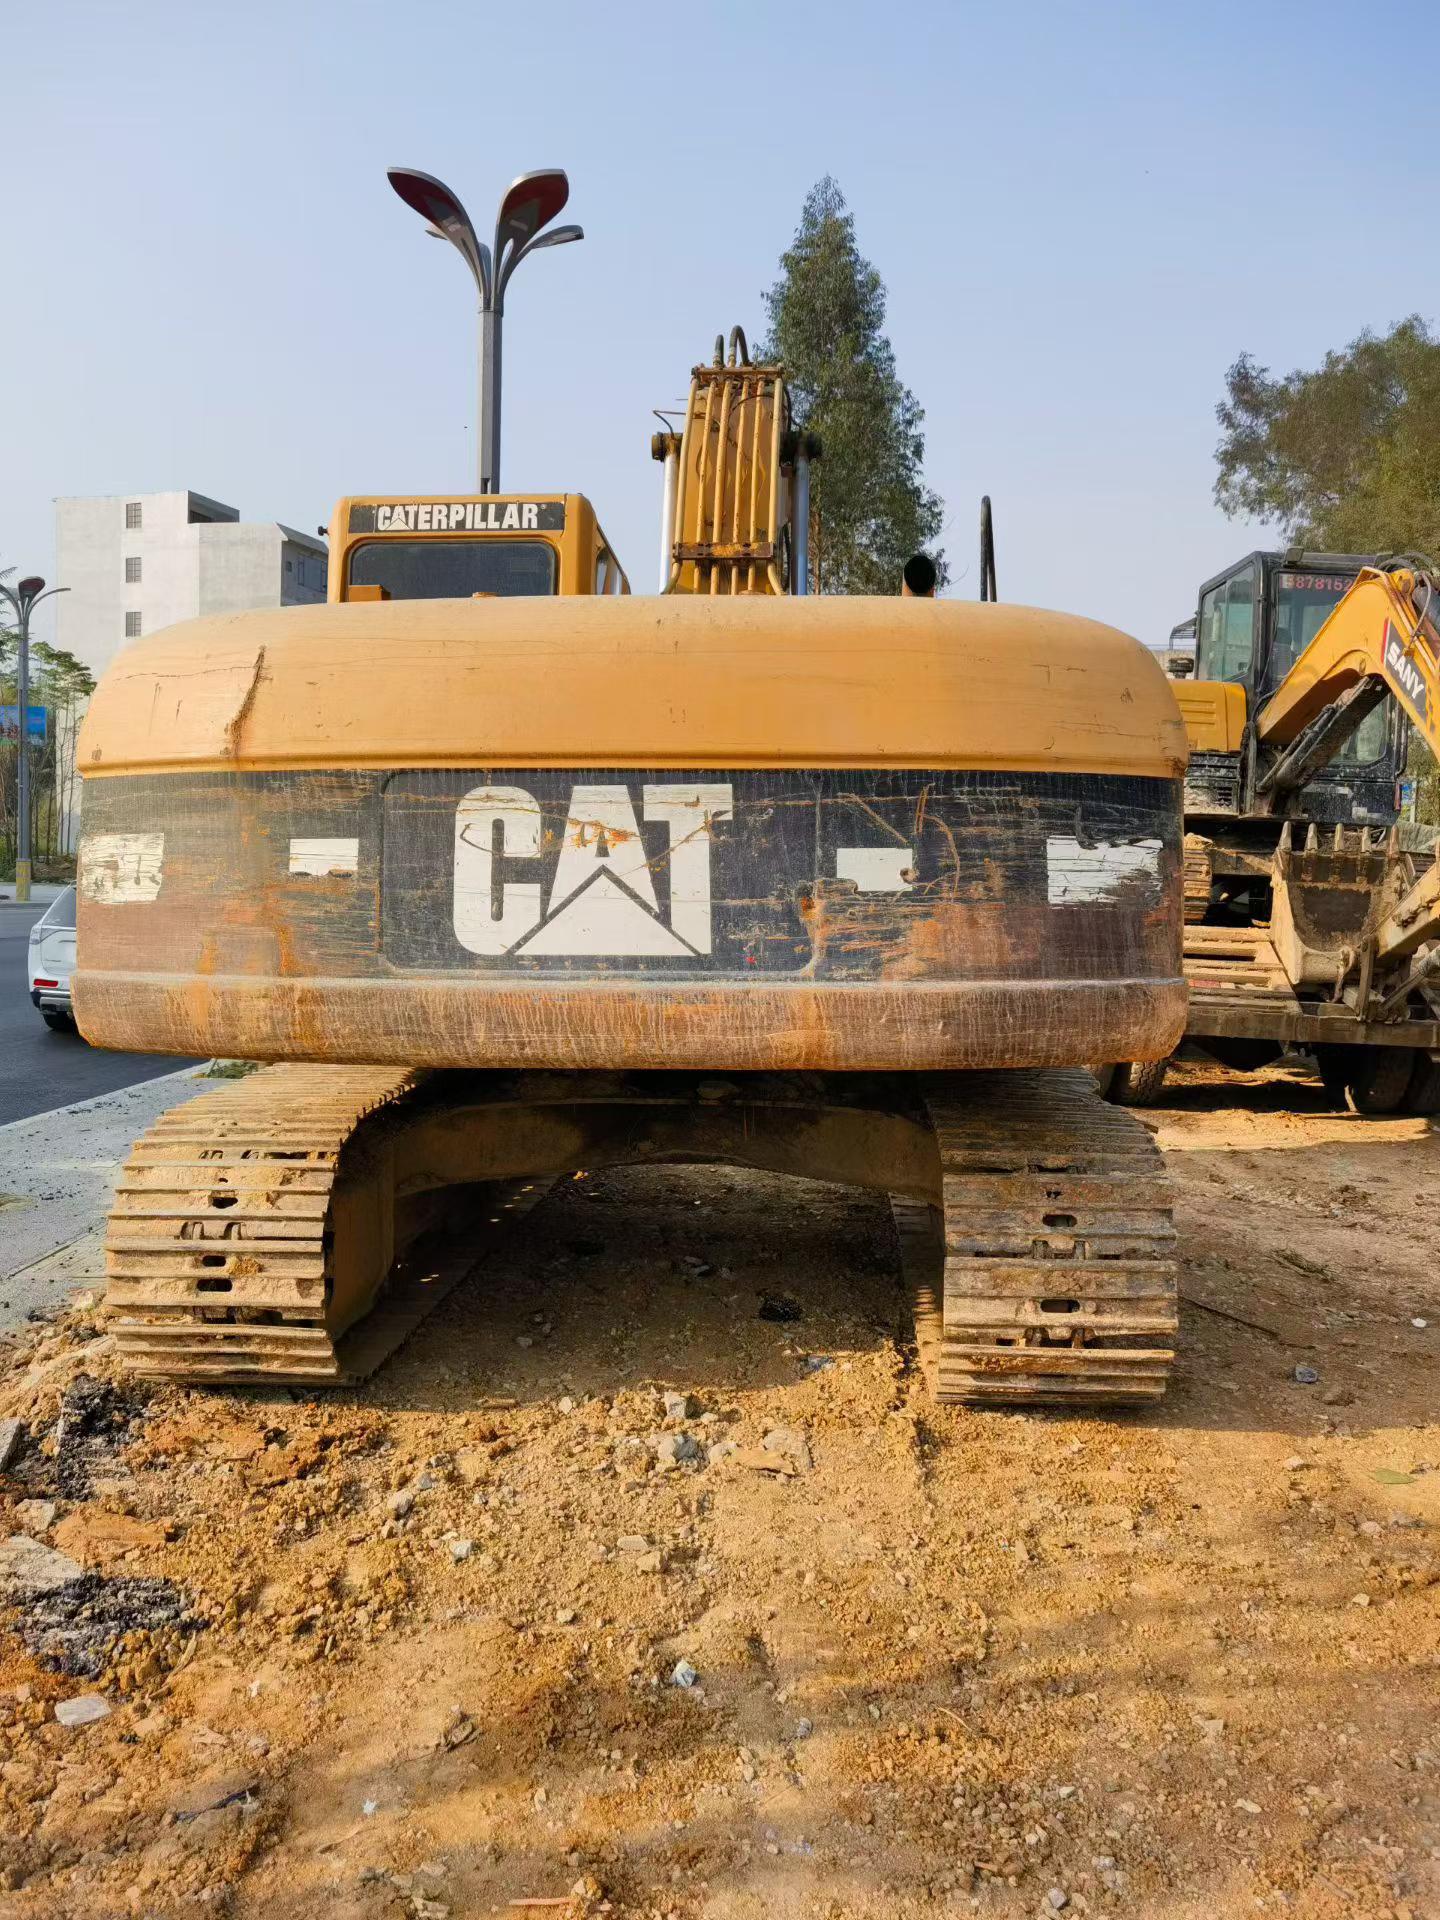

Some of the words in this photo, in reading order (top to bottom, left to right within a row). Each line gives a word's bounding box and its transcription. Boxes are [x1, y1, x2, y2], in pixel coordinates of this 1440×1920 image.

[377, 503, 538, 530] CATERPILLAR
[1387, 642, 1425, 699] SANY
[453, 784, 733, 956] CAT
